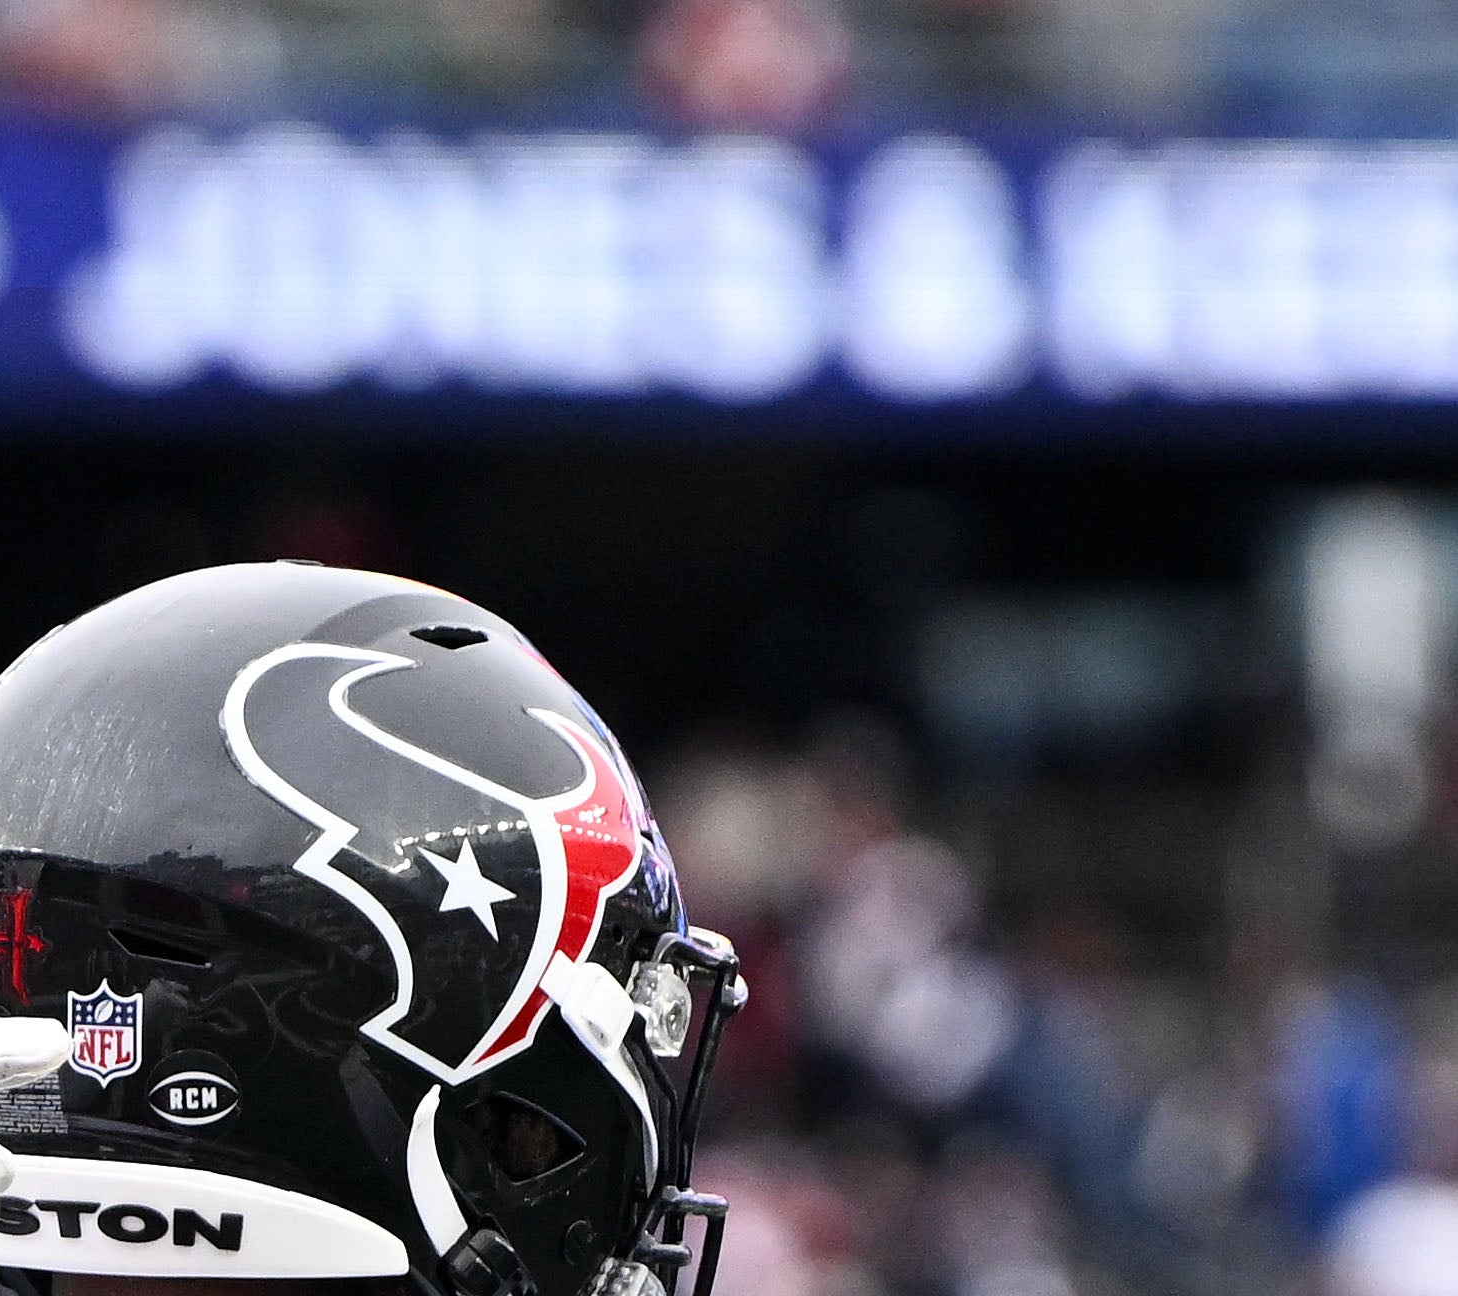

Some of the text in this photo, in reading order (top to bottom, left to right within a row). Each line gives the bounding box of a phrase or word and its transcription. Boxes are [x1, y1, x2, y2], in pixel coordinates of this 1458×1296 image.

[67, 122, 820, 402] JONES
[77, 1028, 131, 1068] NFL
[169, 1087, 217, 1110] RCM
